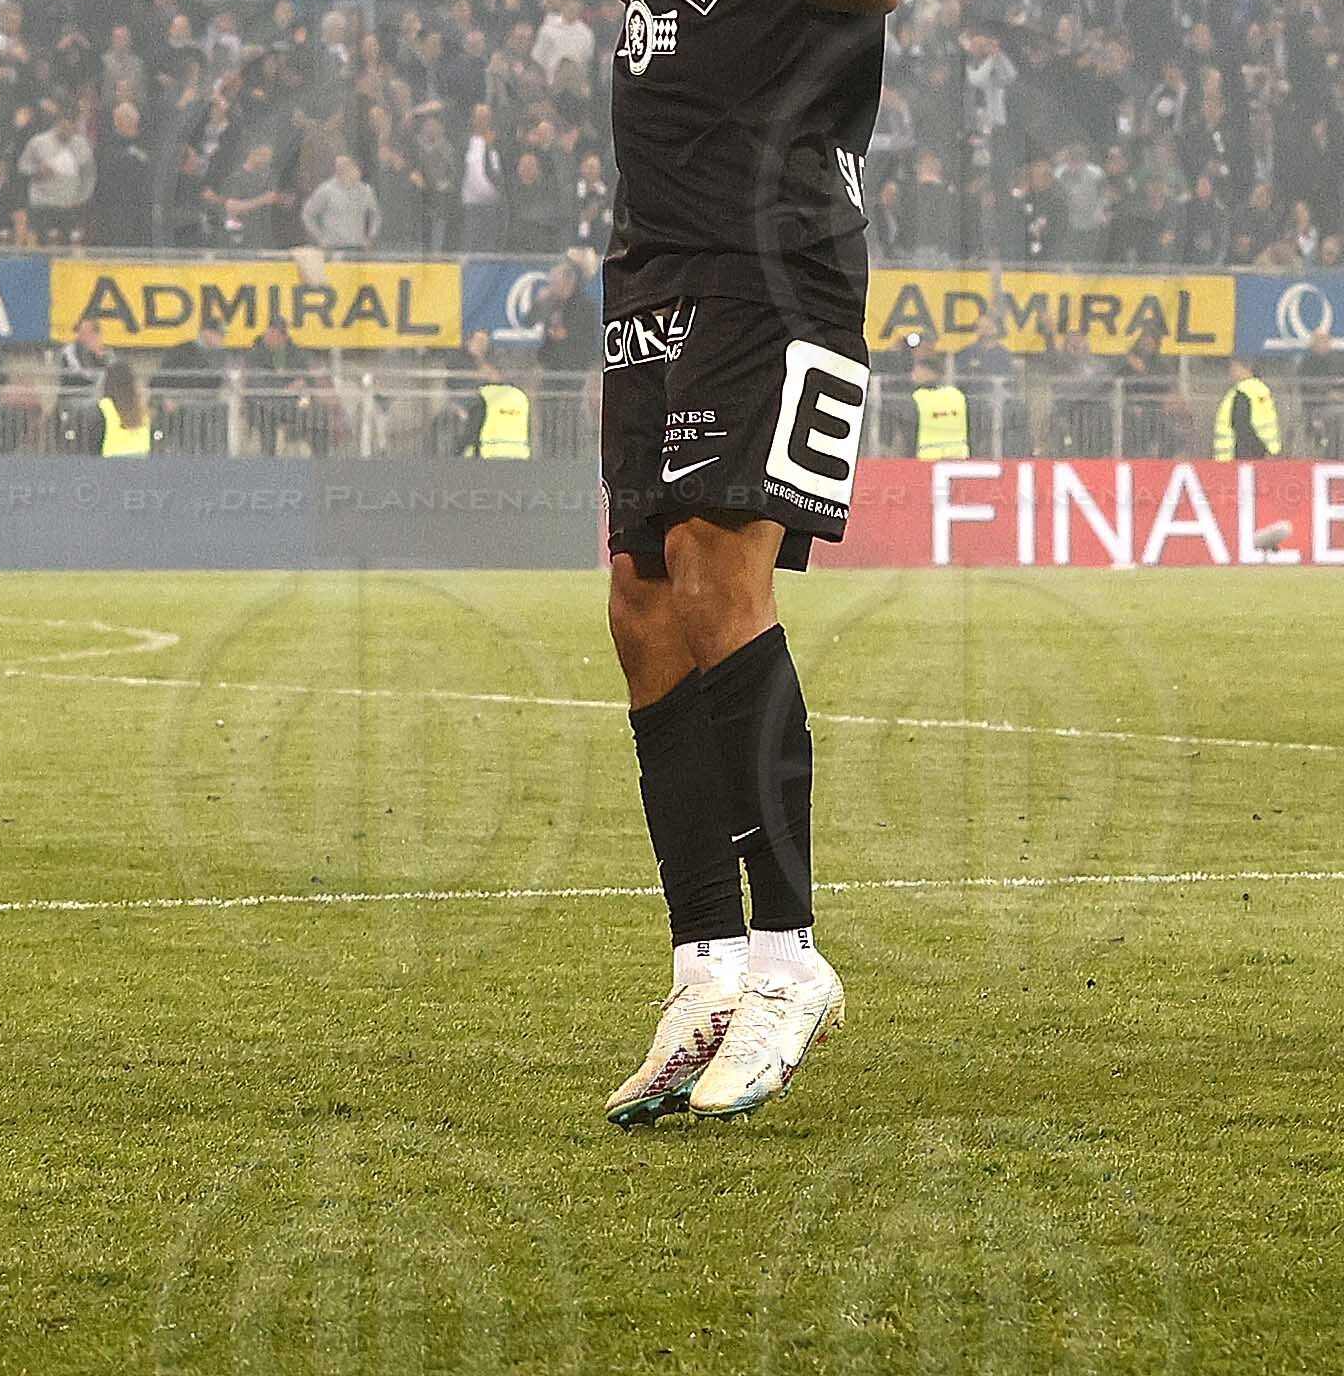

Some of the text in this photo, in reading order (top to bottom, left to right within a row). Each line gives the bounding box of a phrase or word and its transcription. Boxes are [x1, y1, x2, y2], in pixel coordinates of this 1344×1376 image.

[74, 276, 442, 336] ADMIRAL
[878, 283, 1216, 343] ADMIRAL
[788, 367, 864, 481] E
